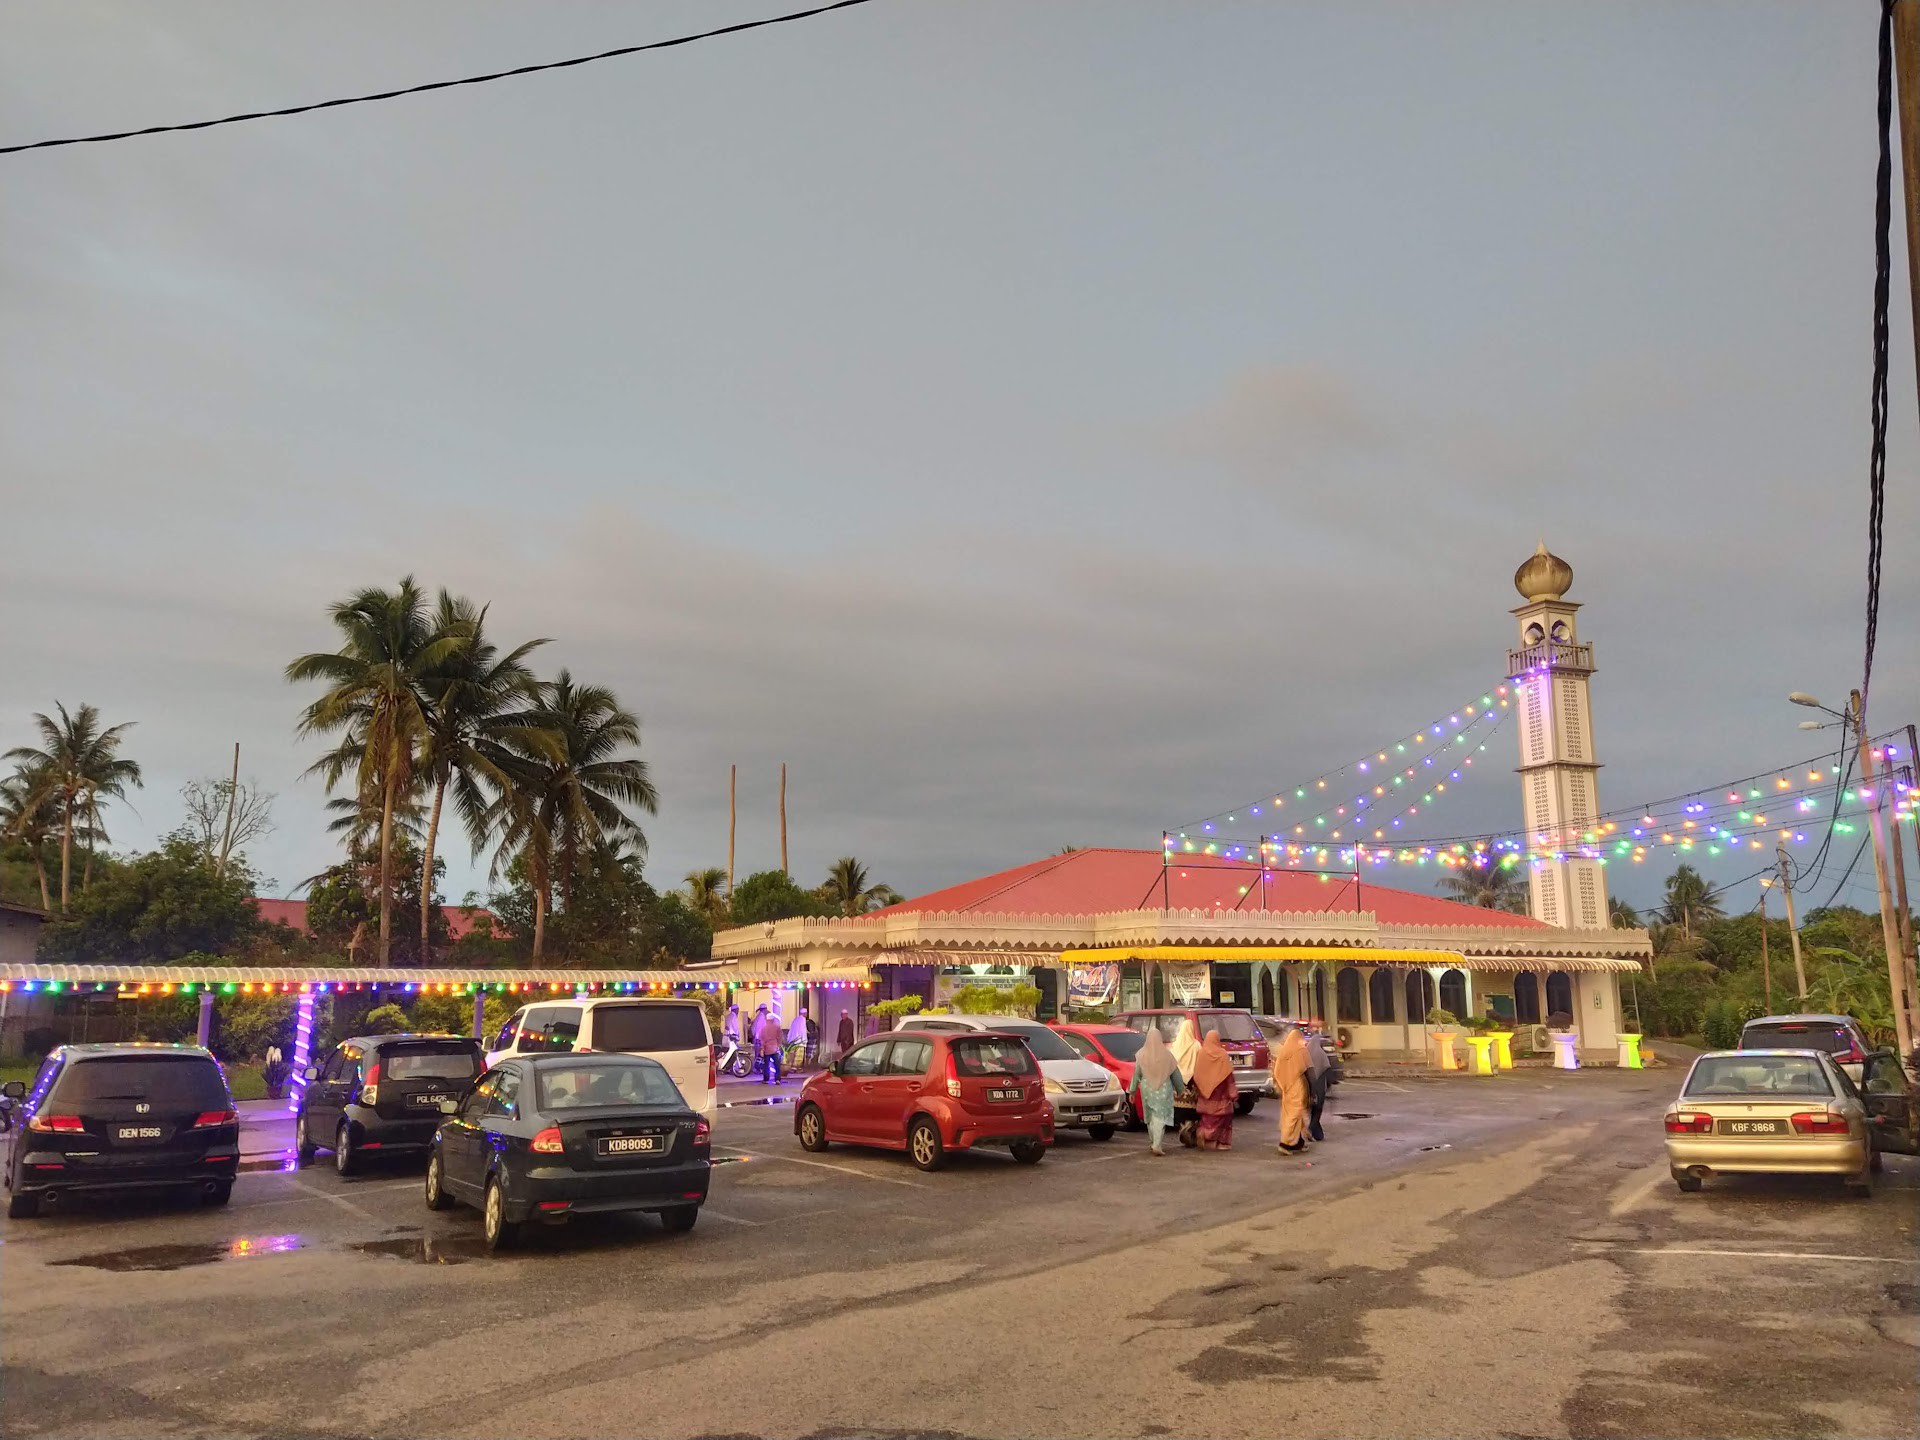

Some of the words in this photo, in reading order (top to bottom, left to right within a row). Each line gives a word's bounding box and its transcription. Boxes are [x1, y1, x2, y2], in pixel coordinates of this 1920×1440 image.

[119, 1128, 138, 1139] DEN
[139, 1127, 161, 1138] 1566
[1731, 1122, 1750, 1132] KBF
[1751, 1122, 1775, 1132] 3868
[608, 1138, 653, 1152] KDB8093
